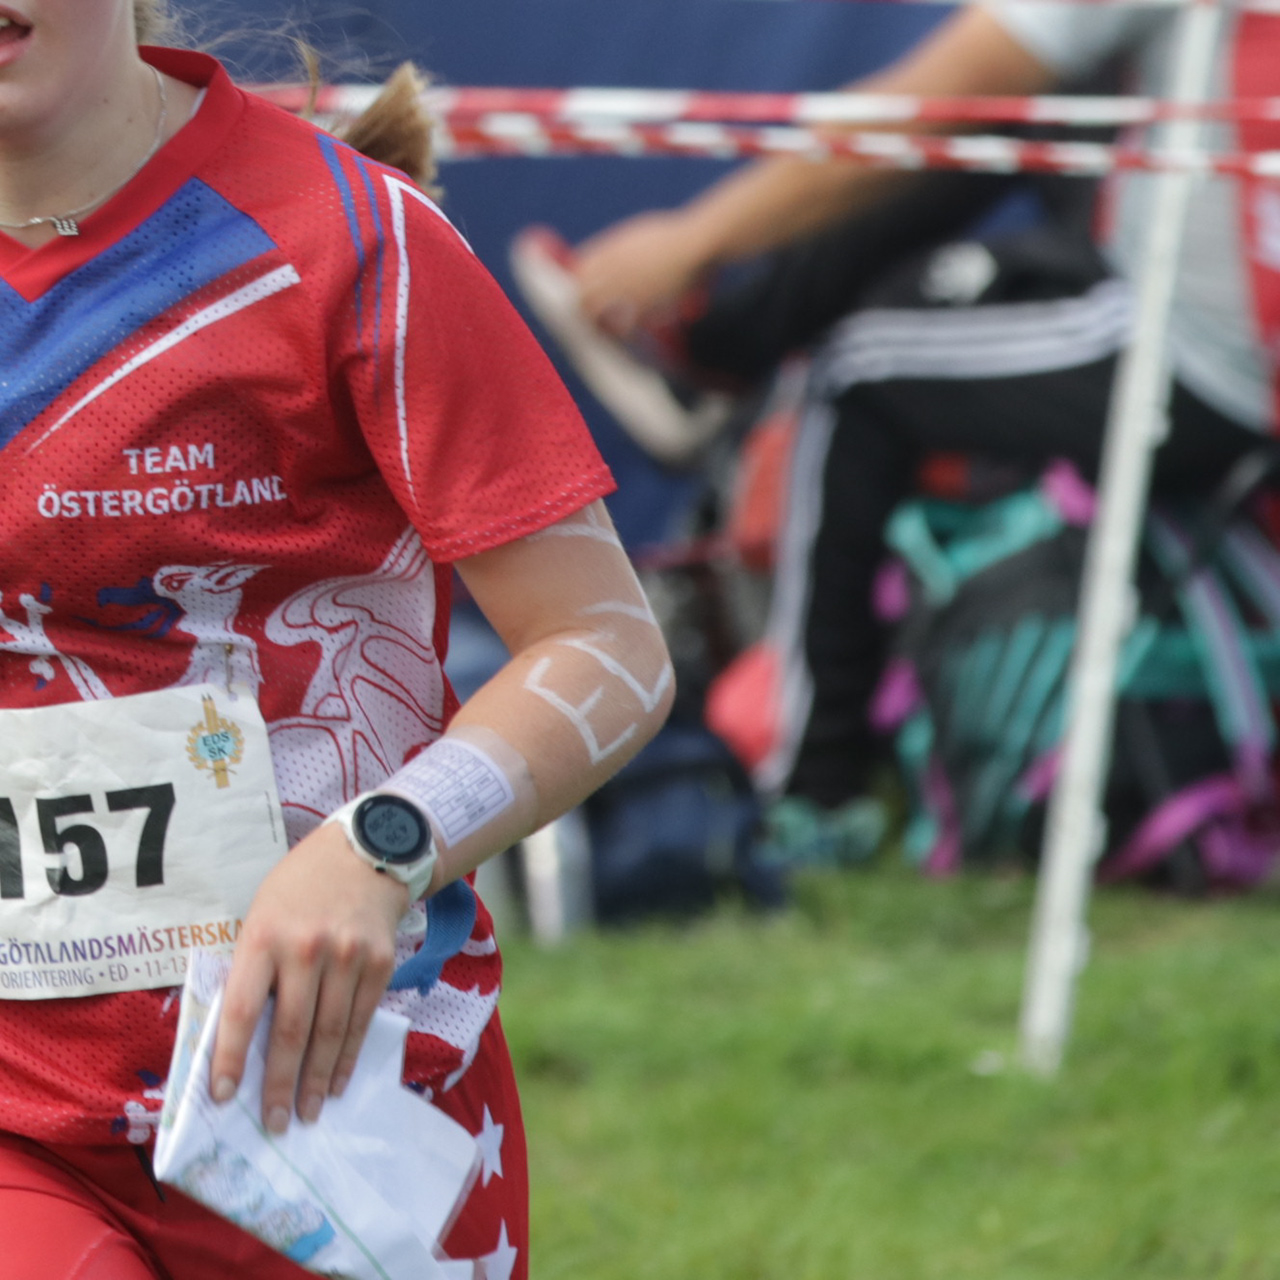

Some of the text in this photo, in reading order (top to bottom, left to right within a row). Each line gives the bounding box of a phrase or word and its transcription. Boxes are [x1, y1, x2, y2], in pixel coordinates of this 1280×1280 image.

[122, 443, 215, 475] TEAM
[202, 731, 230, 747] EDS
[208, 747, 228, 759] SK
[0, 956, 188, 990] ORIENTERING ED 11-13
